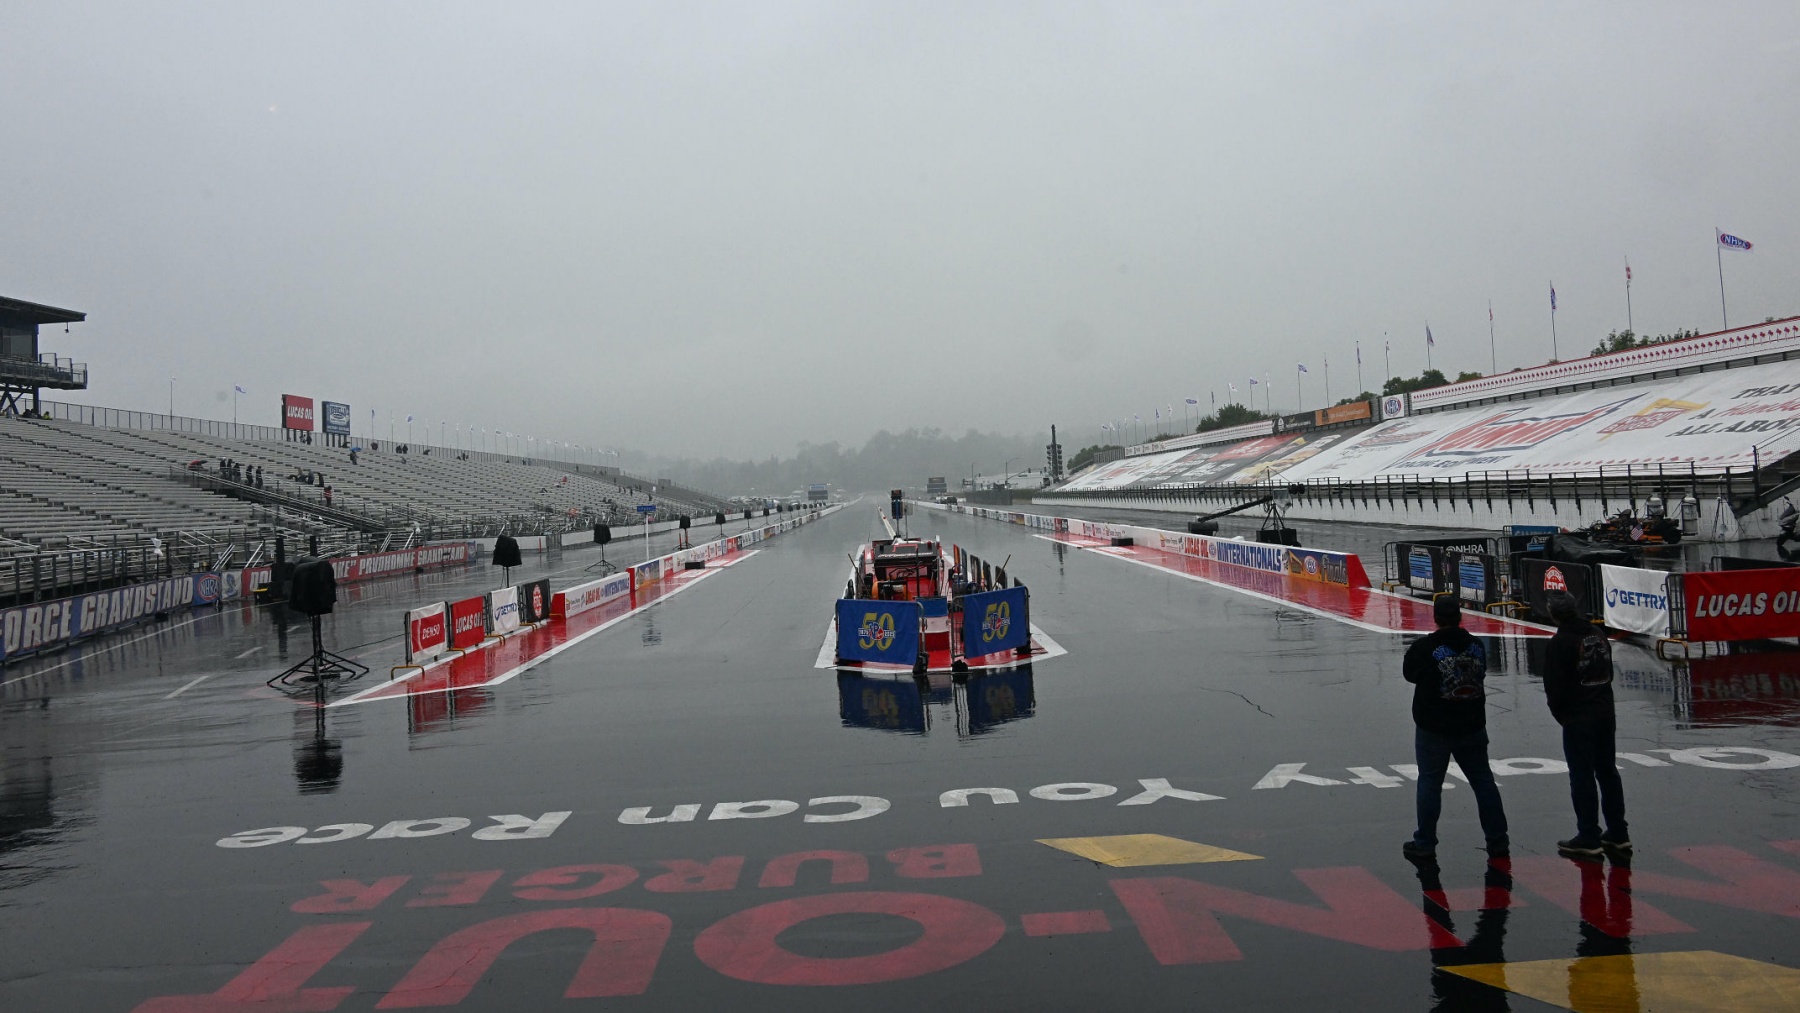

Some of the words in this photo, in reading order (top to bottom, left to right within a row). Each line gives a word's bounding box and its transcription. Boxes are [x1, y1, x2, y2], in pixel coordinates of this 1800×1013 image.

[1724, 235, 1748, 249] NHRA
[287, 405, 304, 419] LUCAS
[304, 408, 313, 420] OIL
[1665, 424, 1719, 437] ALL
[359, 551, 415, 576] PRUDHOMME
[1216, 541, 1282, 572] WINTERNATIONALS
[1321, 554, 1348, 585] Finals
[200, 580, 219, 596] NHRA
[1619, 590, 1667, 611] GETTRX
[0, 601, 73, 654] ORCE
[80, 577, 194, 634] GRANDSTAND
[1694, 592, 1768, 618] LUCAS
[422, 623, 441, 641] DENSO
[455, 616, 473, 634] LUCAS
[858, 612, 895, 651] 50
[982, 601, 1010, 643] 50
[939, 777, 1228, 808] You
[617, 795, 892, 825] Can
[215, 810, 574, 849] Race
[290, 843, 983, 914] BURGER
